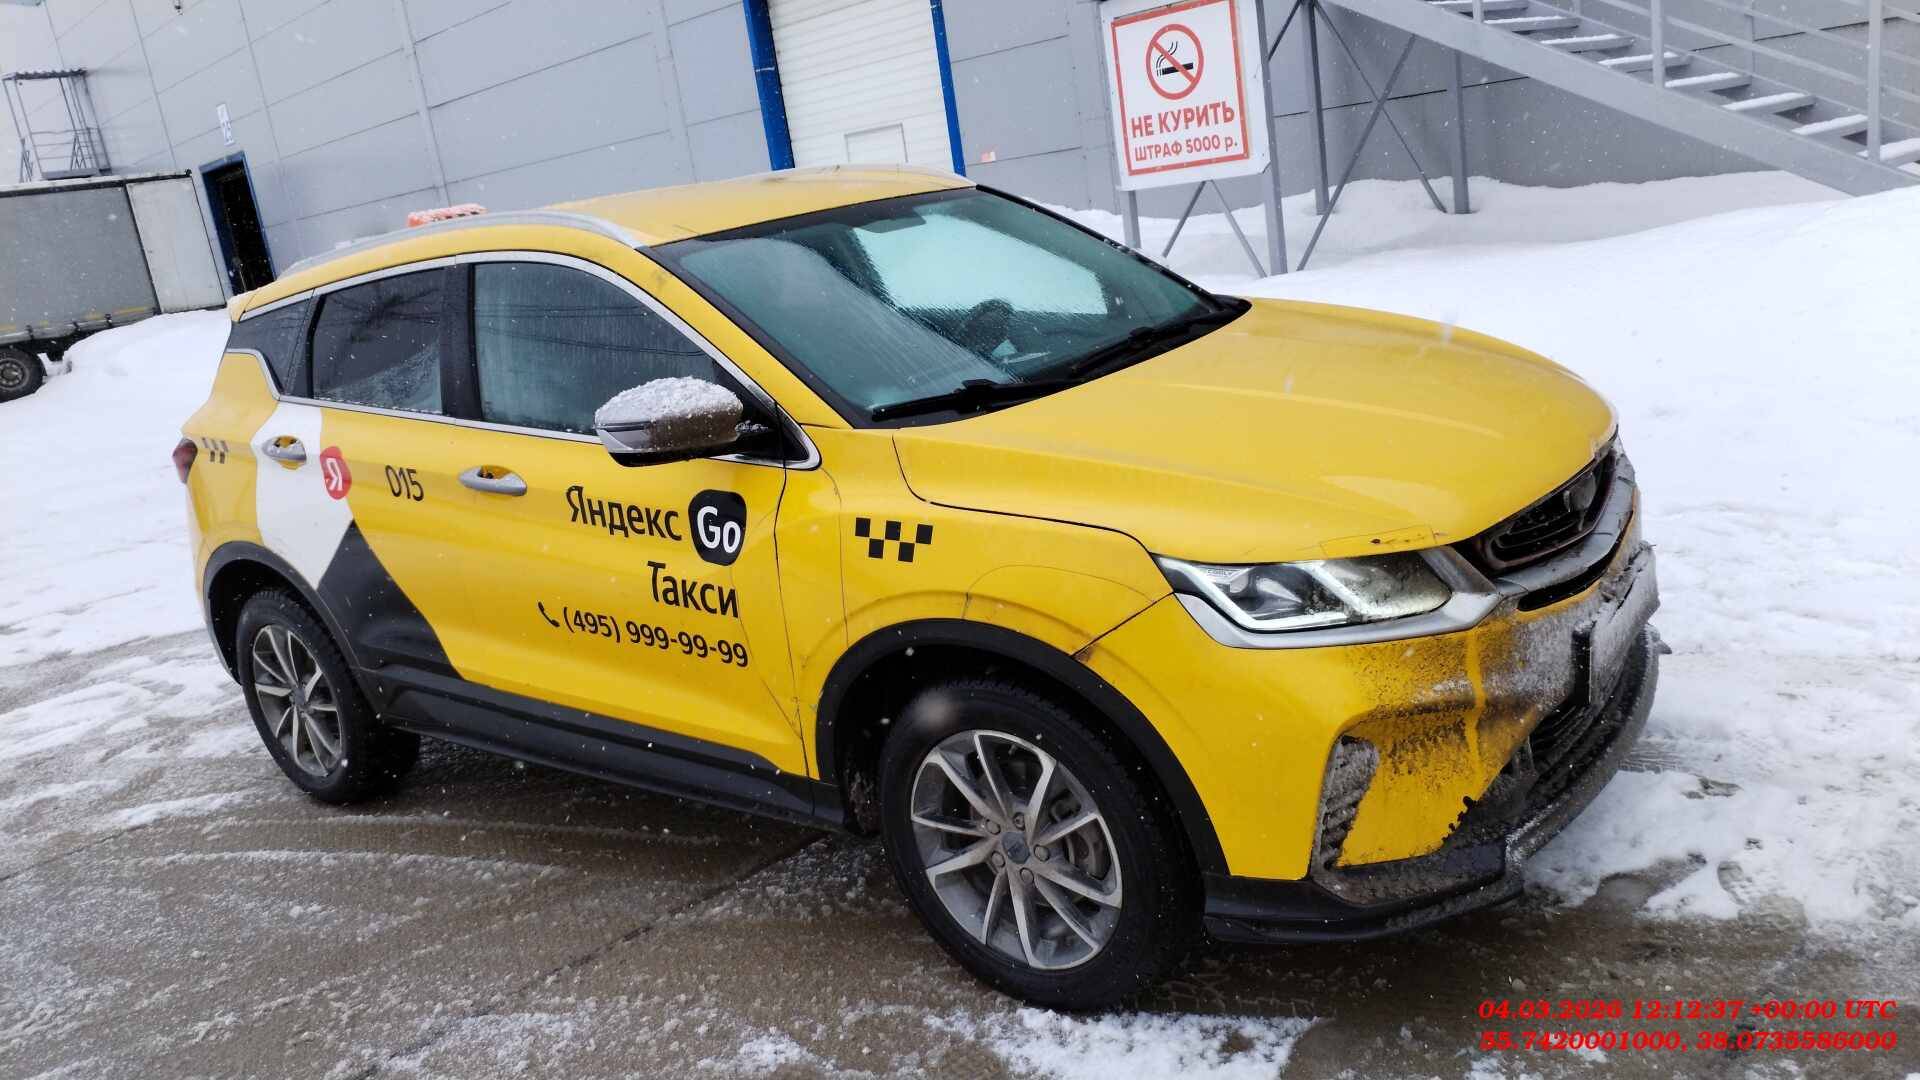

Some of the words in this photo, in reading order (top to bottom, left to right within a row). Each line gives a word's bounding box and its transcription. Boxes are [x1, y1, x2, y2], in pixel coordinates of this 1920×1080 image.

[1131, 114, 1154, 138] НЕ
[1158, 101, 1235, 133] КУРИТЬ
[1134, 141, 1182, 161] ШТРАФ
[1185, 135, 1220, 153] 5000
[326, 457, 343, 491] Я
[385, 465, 424, 501] 015
[566, 485, 682, 541] Яндекс
[697, 506, 741, 553] Go
[647, 560, 739, 618] Такси
[563, 606, 621, 643] (495)
[626, 620, 748, 668] 999-99-99
